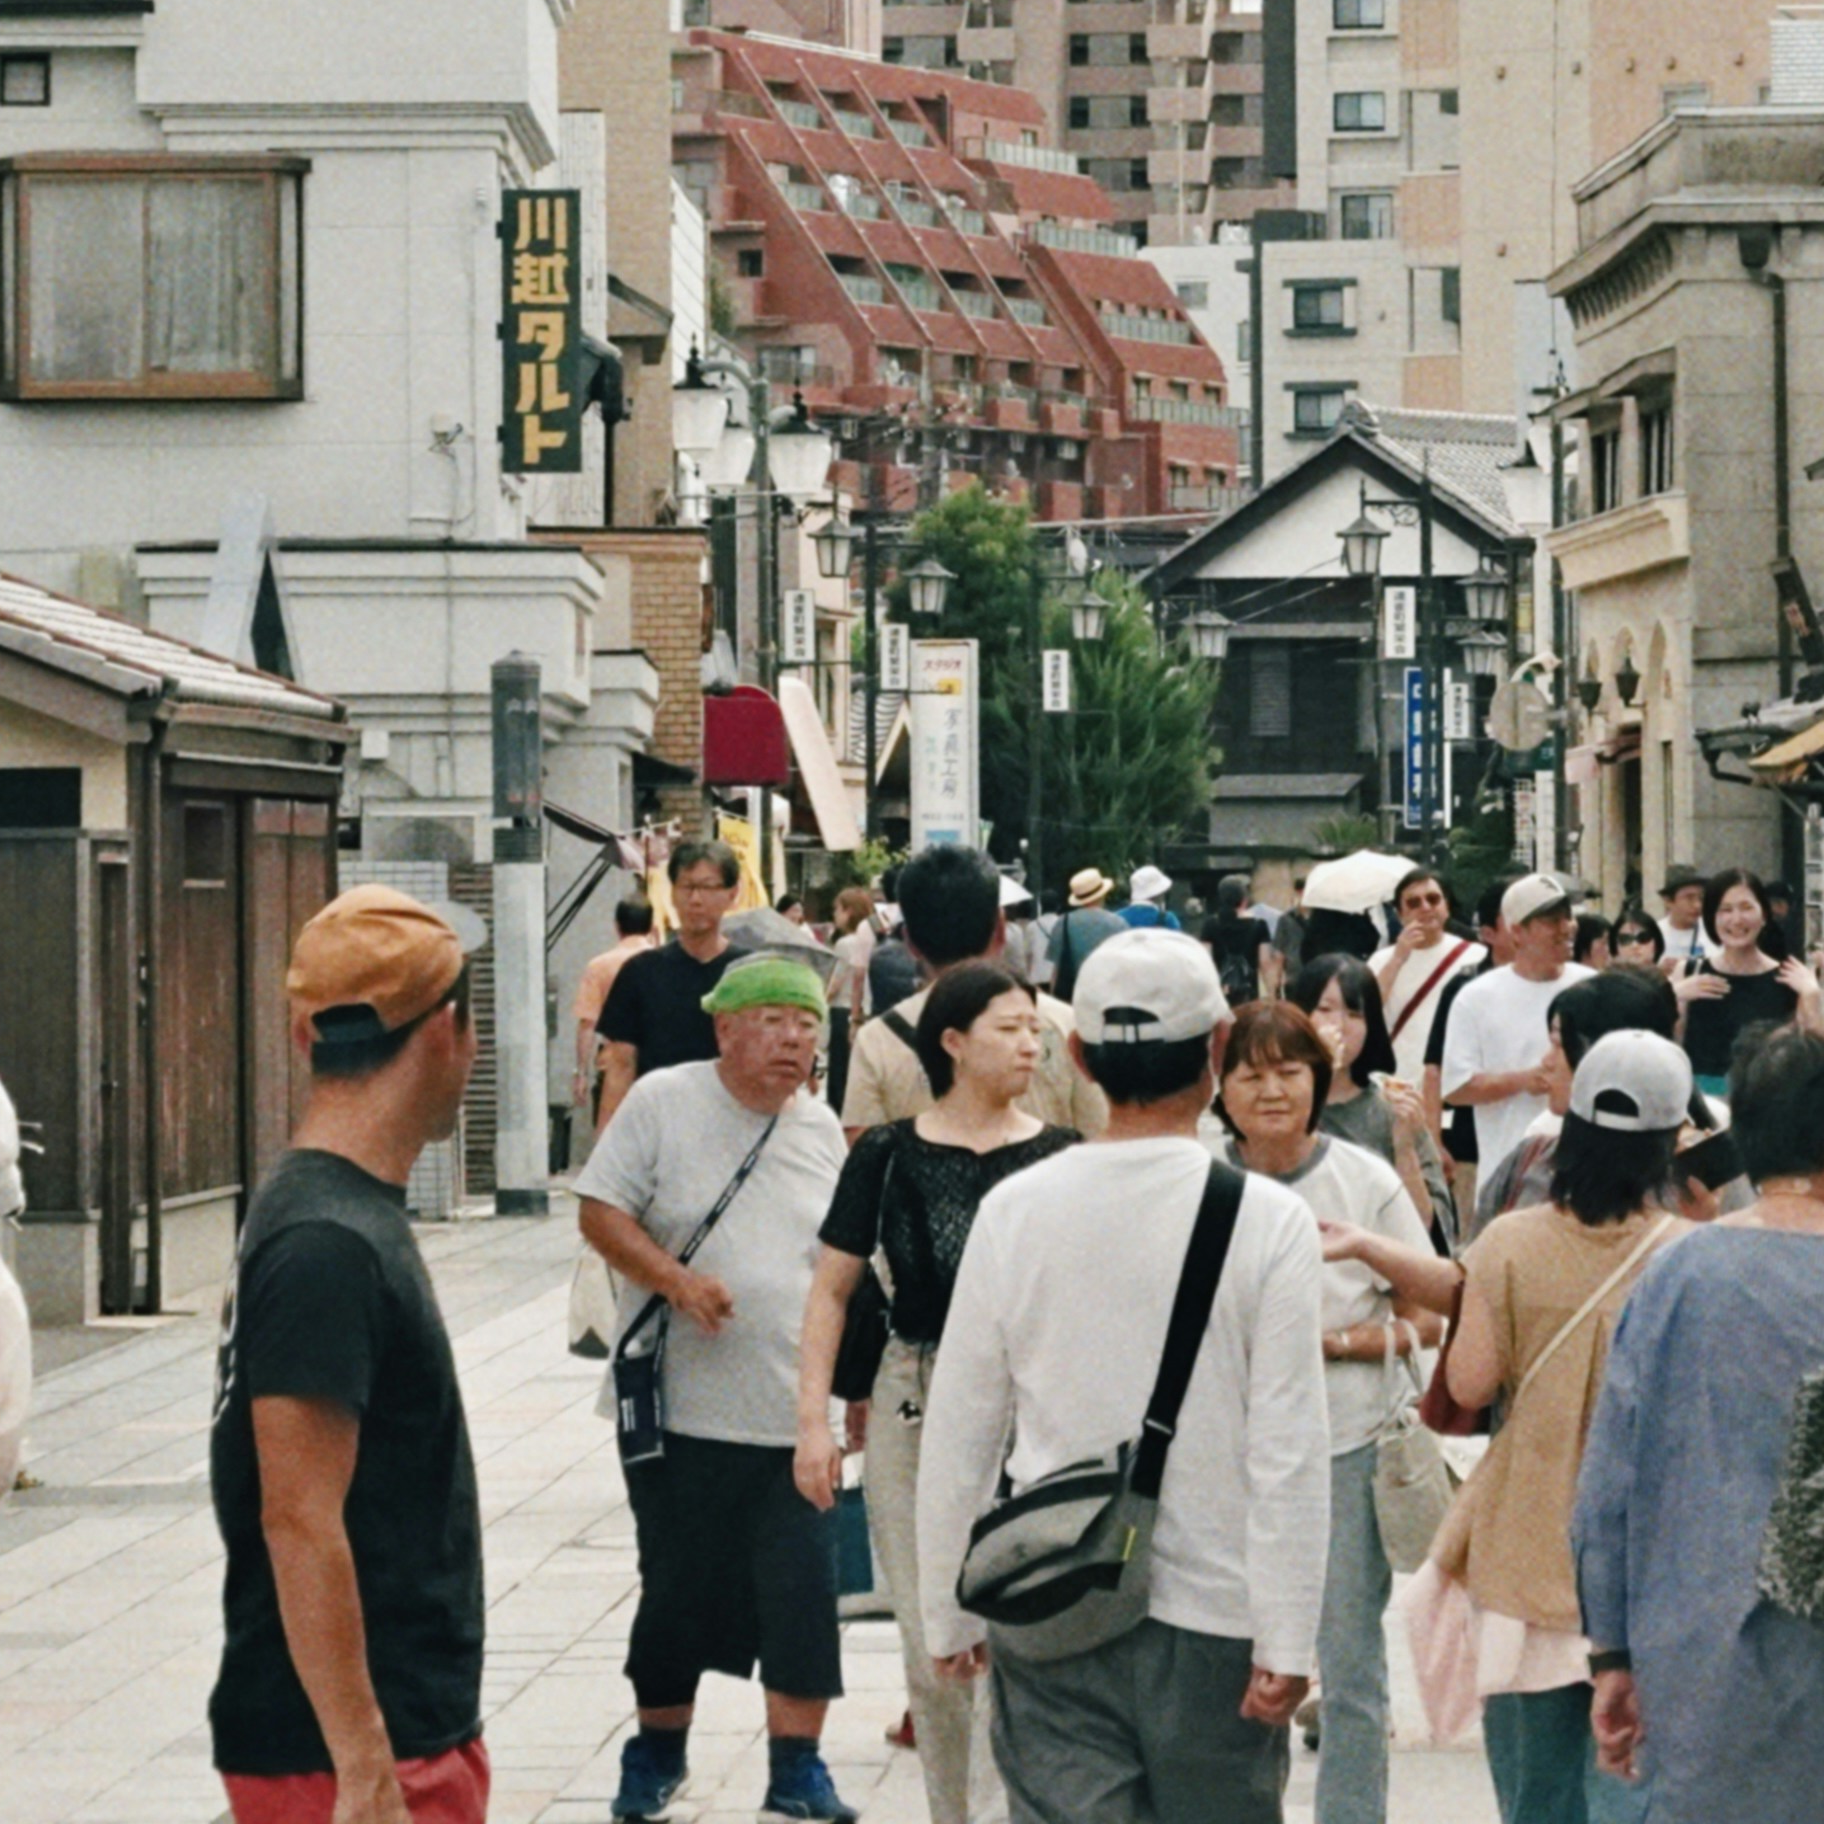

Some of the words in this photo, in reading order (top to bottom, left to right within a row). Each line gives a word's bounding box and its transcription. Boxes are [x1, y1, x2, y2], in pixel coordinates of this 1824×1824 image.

[510, 196, 571, 466] 川越タルト
